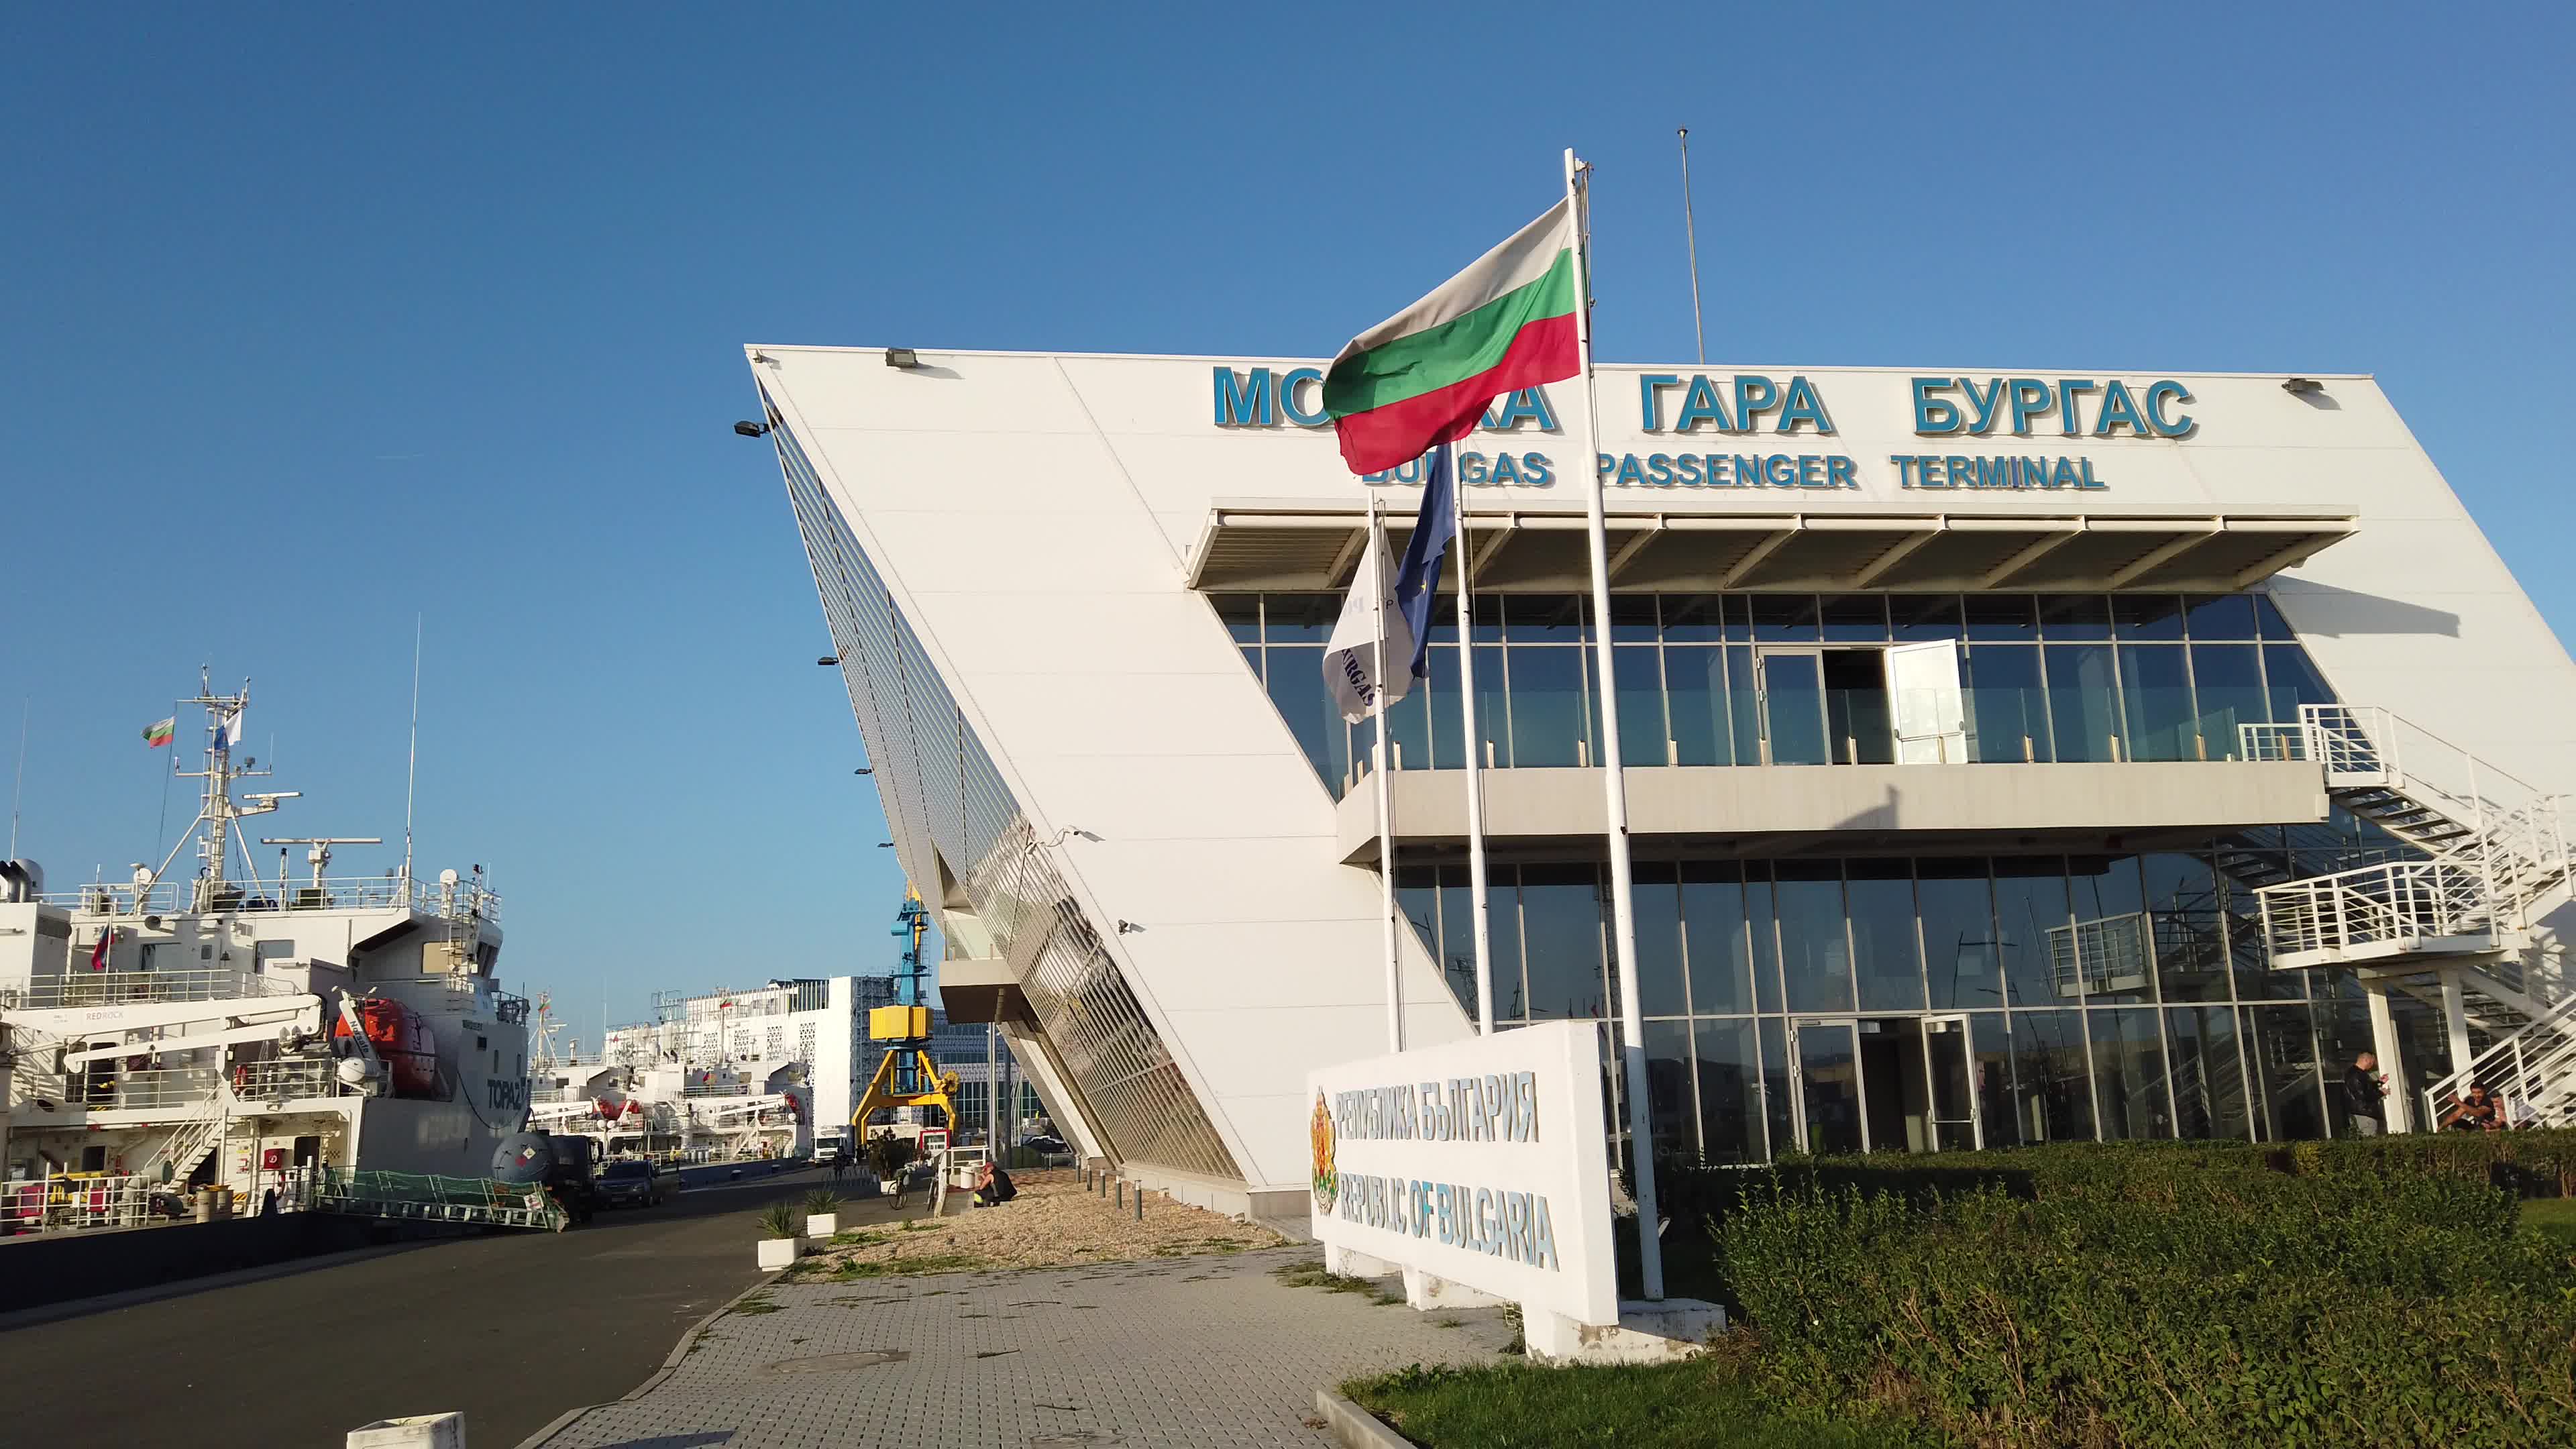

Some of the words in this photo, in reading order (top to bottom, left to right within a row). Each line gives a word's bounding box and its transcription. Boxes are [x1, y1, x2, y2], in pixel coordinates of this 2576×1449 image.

[1214, 366, 1555, 430] МОА
[1640, 374, 1833, 432] ГАРА
[1911, 377, 2194, 436] БУРГАС
[1599, 453, 1856, 488] PASSENGER
[1890, 455, 2105, 489] TERMINAL
[1335, 1084, 1420, 1140] РЕПУБЛИКА
[1420, 1071, 1540, 1142] БЪЛГАРИЯ
[1340, 1172, 1407, 1235] REPUBLIC
[1409, 1179, 1434, 1239] OF
[1435, 1183, 1560, 1273] BULGARIA
